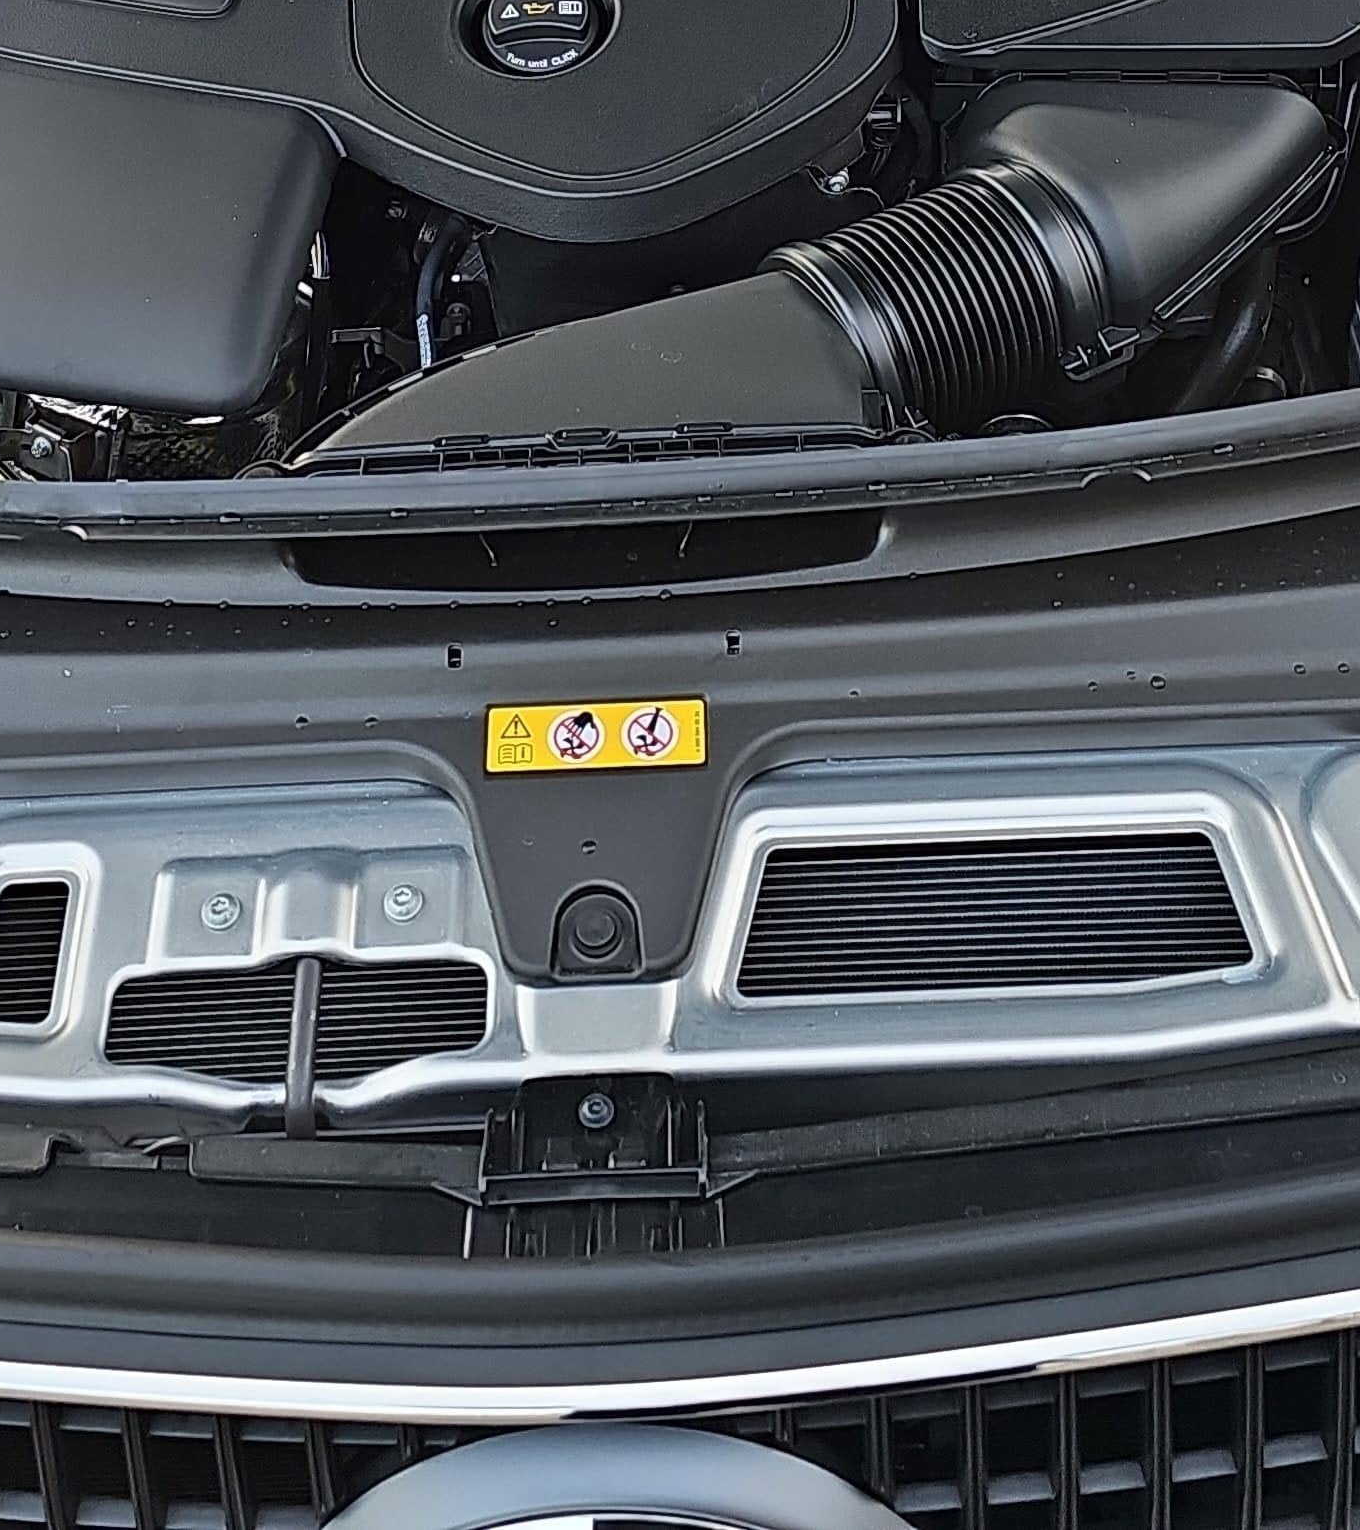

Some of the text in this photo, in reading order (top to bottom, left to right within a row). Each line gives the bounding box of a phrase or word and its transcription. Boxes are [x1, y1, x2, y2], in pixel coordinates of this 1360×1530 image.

[506, 48, 579, 68] Turn until CLICK
